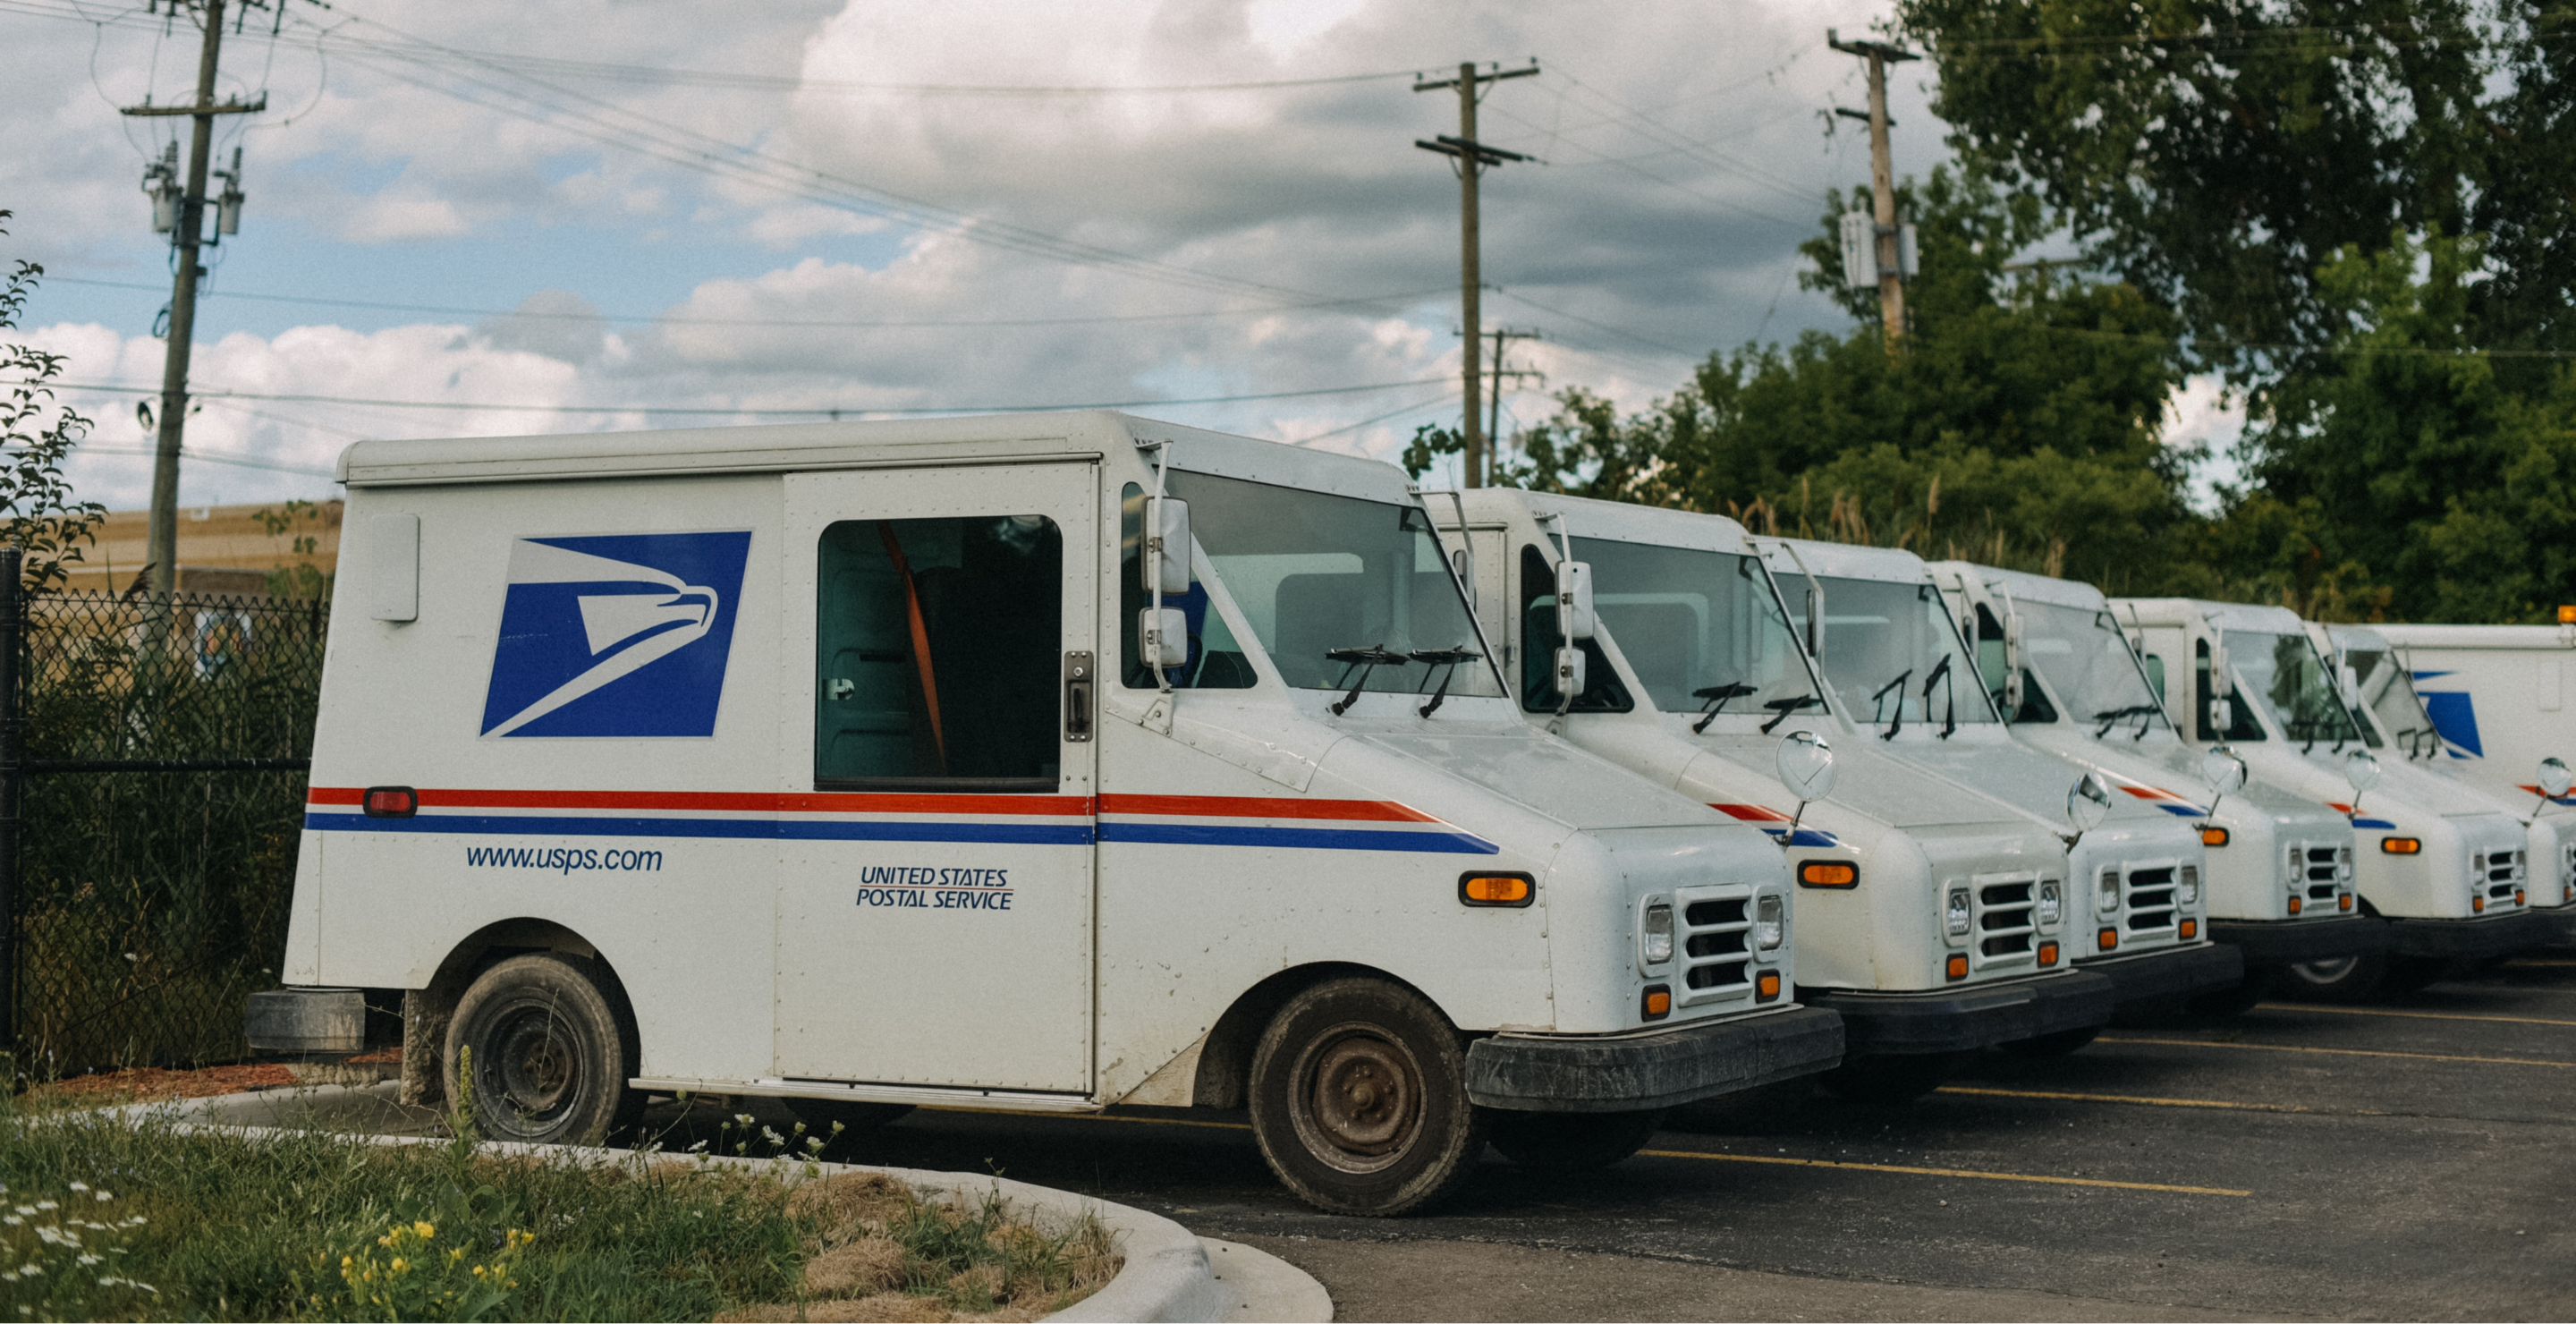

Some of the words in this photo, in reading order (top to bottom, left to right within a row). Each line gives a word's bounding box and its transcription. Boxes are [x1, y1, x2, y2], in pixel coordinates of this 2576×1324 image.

[467, 846, 663, 876] www.usps.com
[860, 866, 936, 885] UNITED
[938, 868, 1008, 887] STATES
[856, 888, 928, 908] POSTAL
[933, 890, 1014, 910] SERVICE
